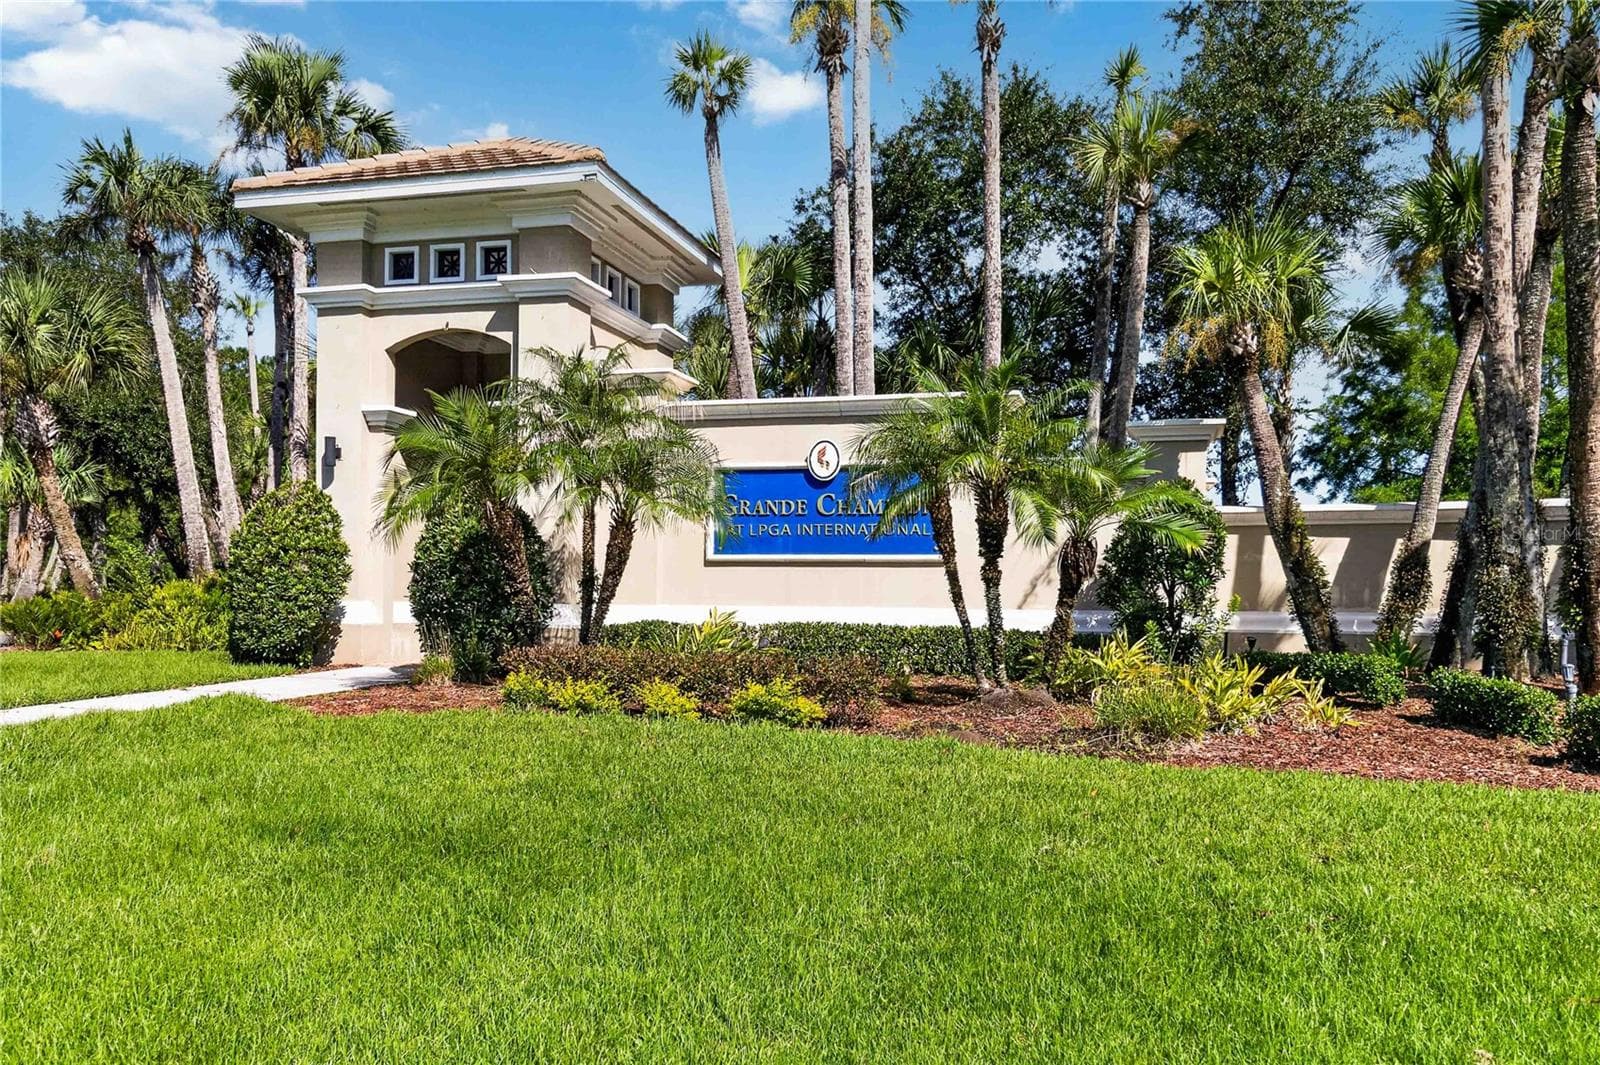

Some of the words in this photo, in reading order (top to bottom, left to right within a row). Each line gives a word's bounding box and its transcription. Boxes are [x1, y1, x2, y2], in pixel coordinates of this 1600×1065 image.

[723, 493, 808, 516] GRANDE
[749, 523, 792, 536] LPGA
[797, 522, 931, 537] INTERNATONAL
